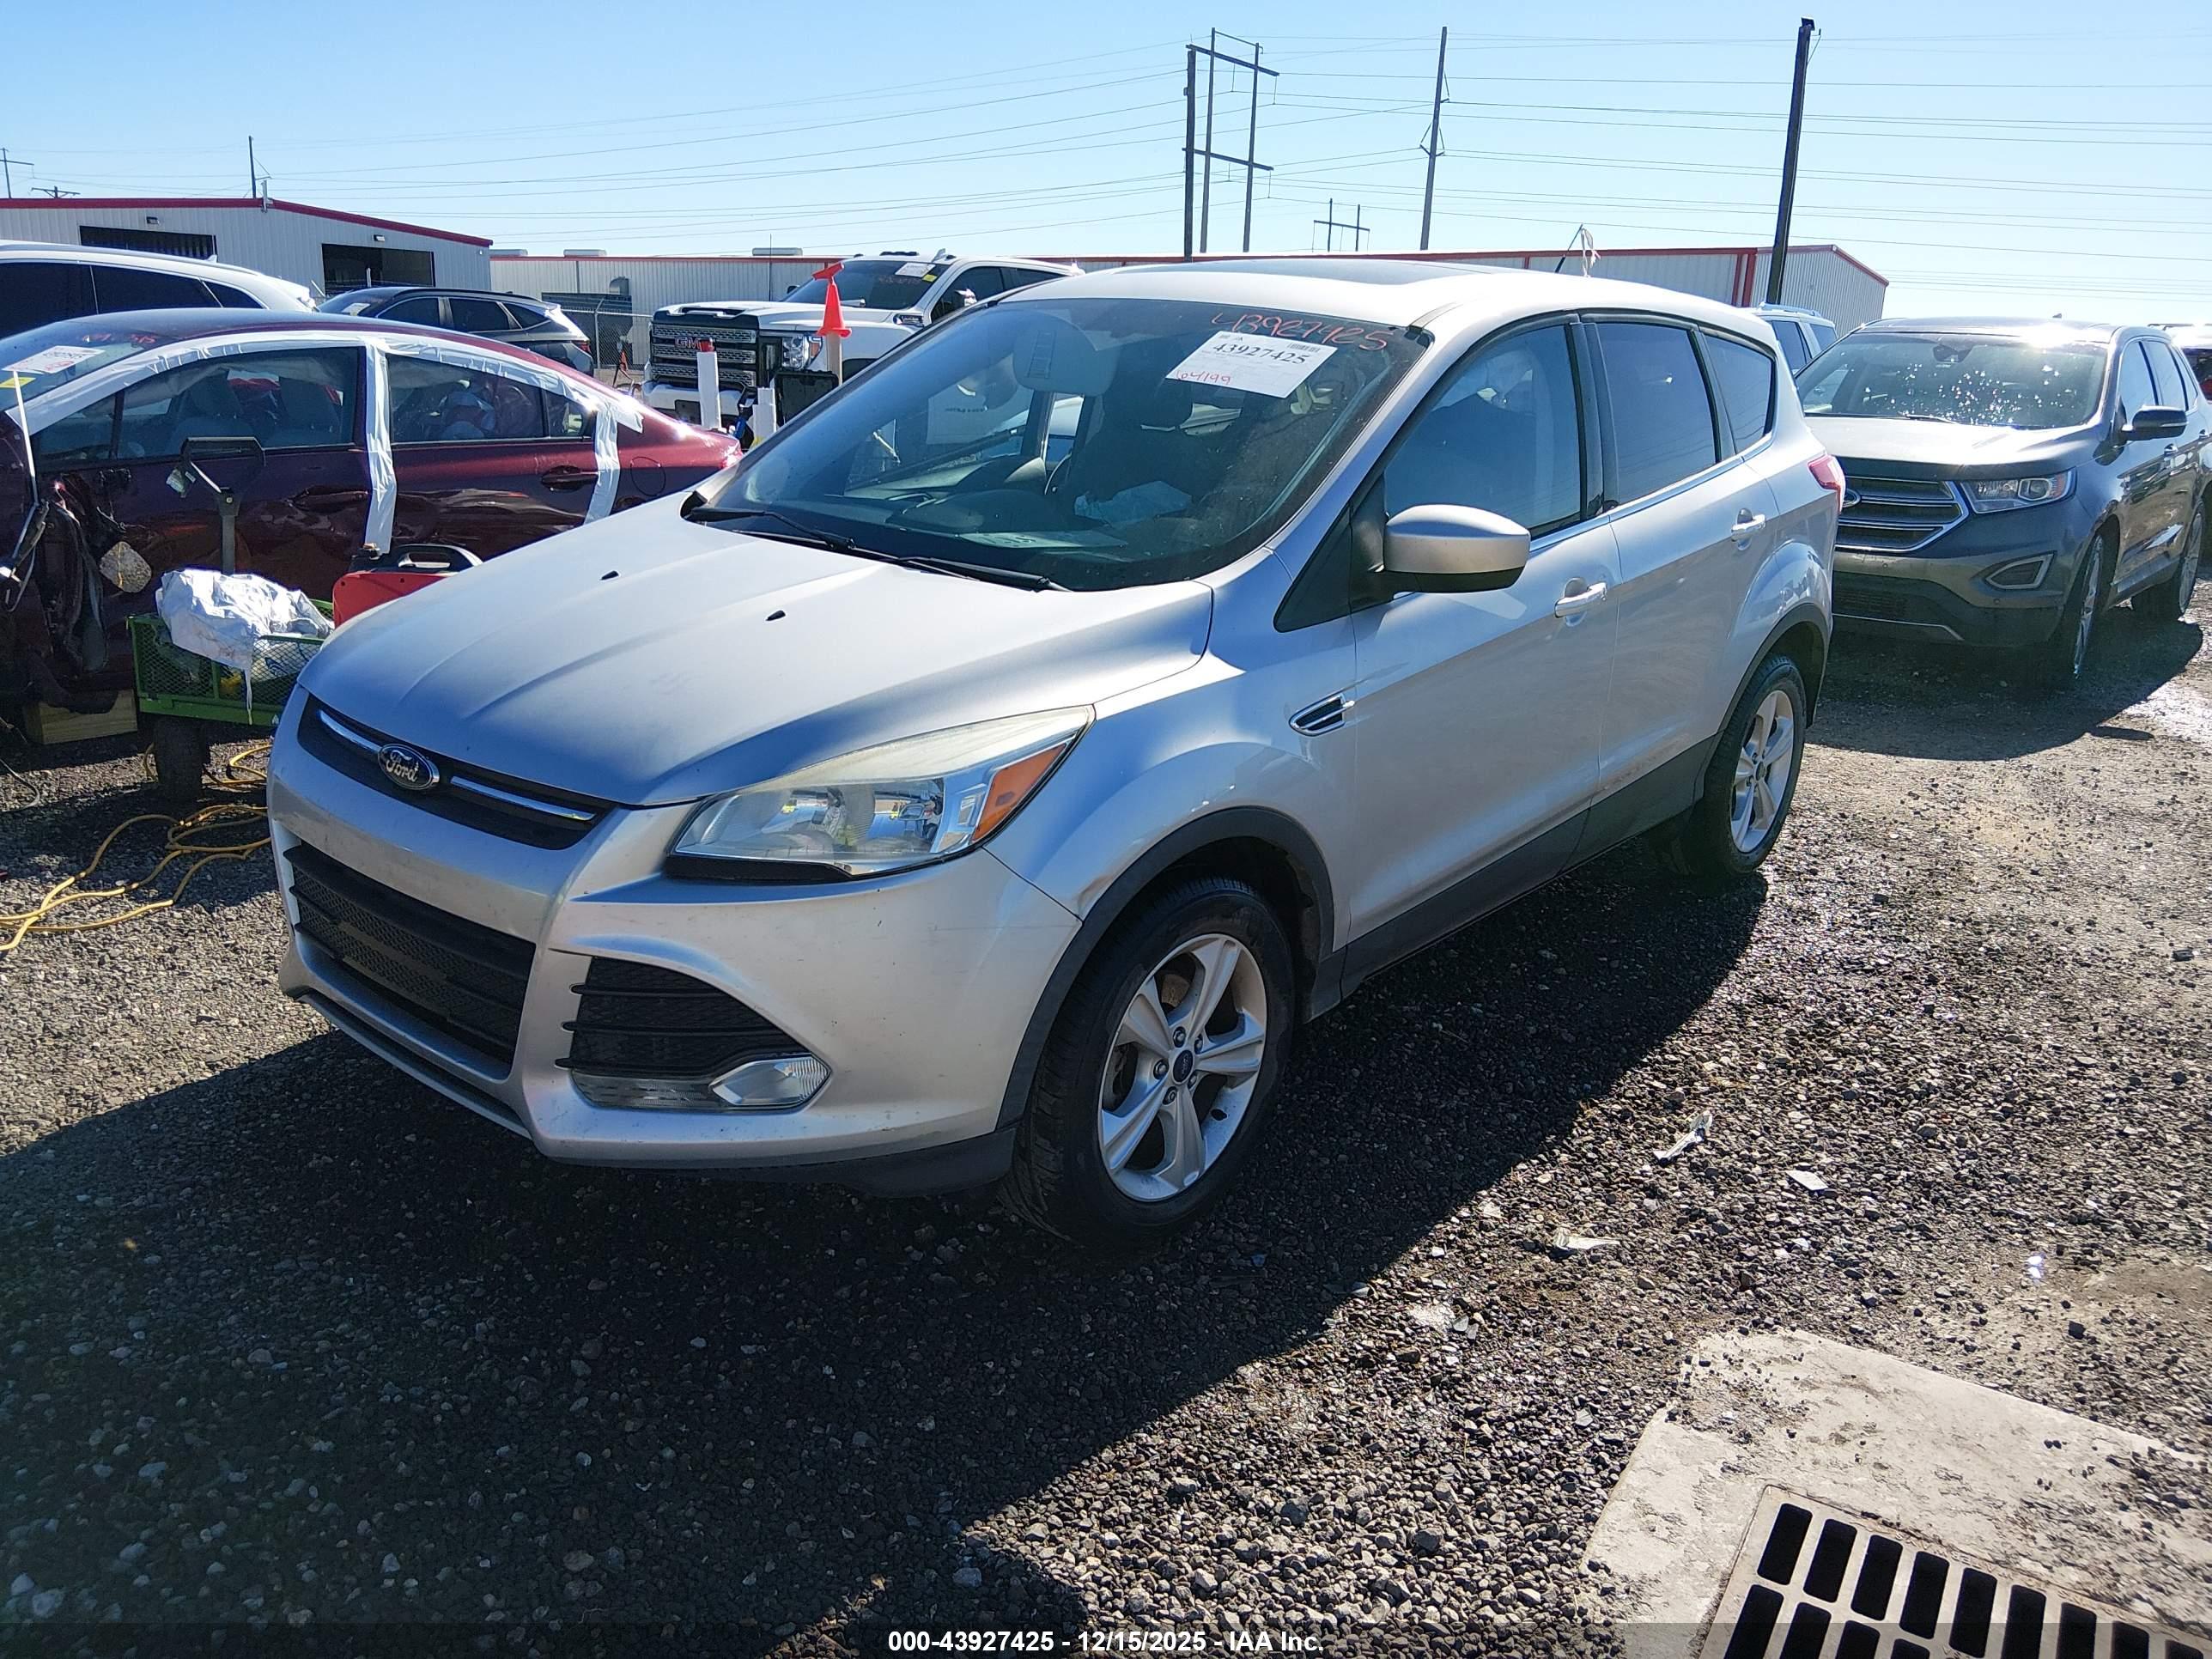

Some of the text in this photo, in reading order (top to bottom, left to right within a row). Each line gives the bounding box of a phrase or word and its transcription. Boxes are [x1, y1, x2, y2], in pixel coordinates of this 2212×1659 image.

[674, 337, 702, 350] GM
[1211, 312, 1395, 351] 43927425
[1212, 343, 1310, 365] 43927425
[386, 750, 419, 782] Ford
